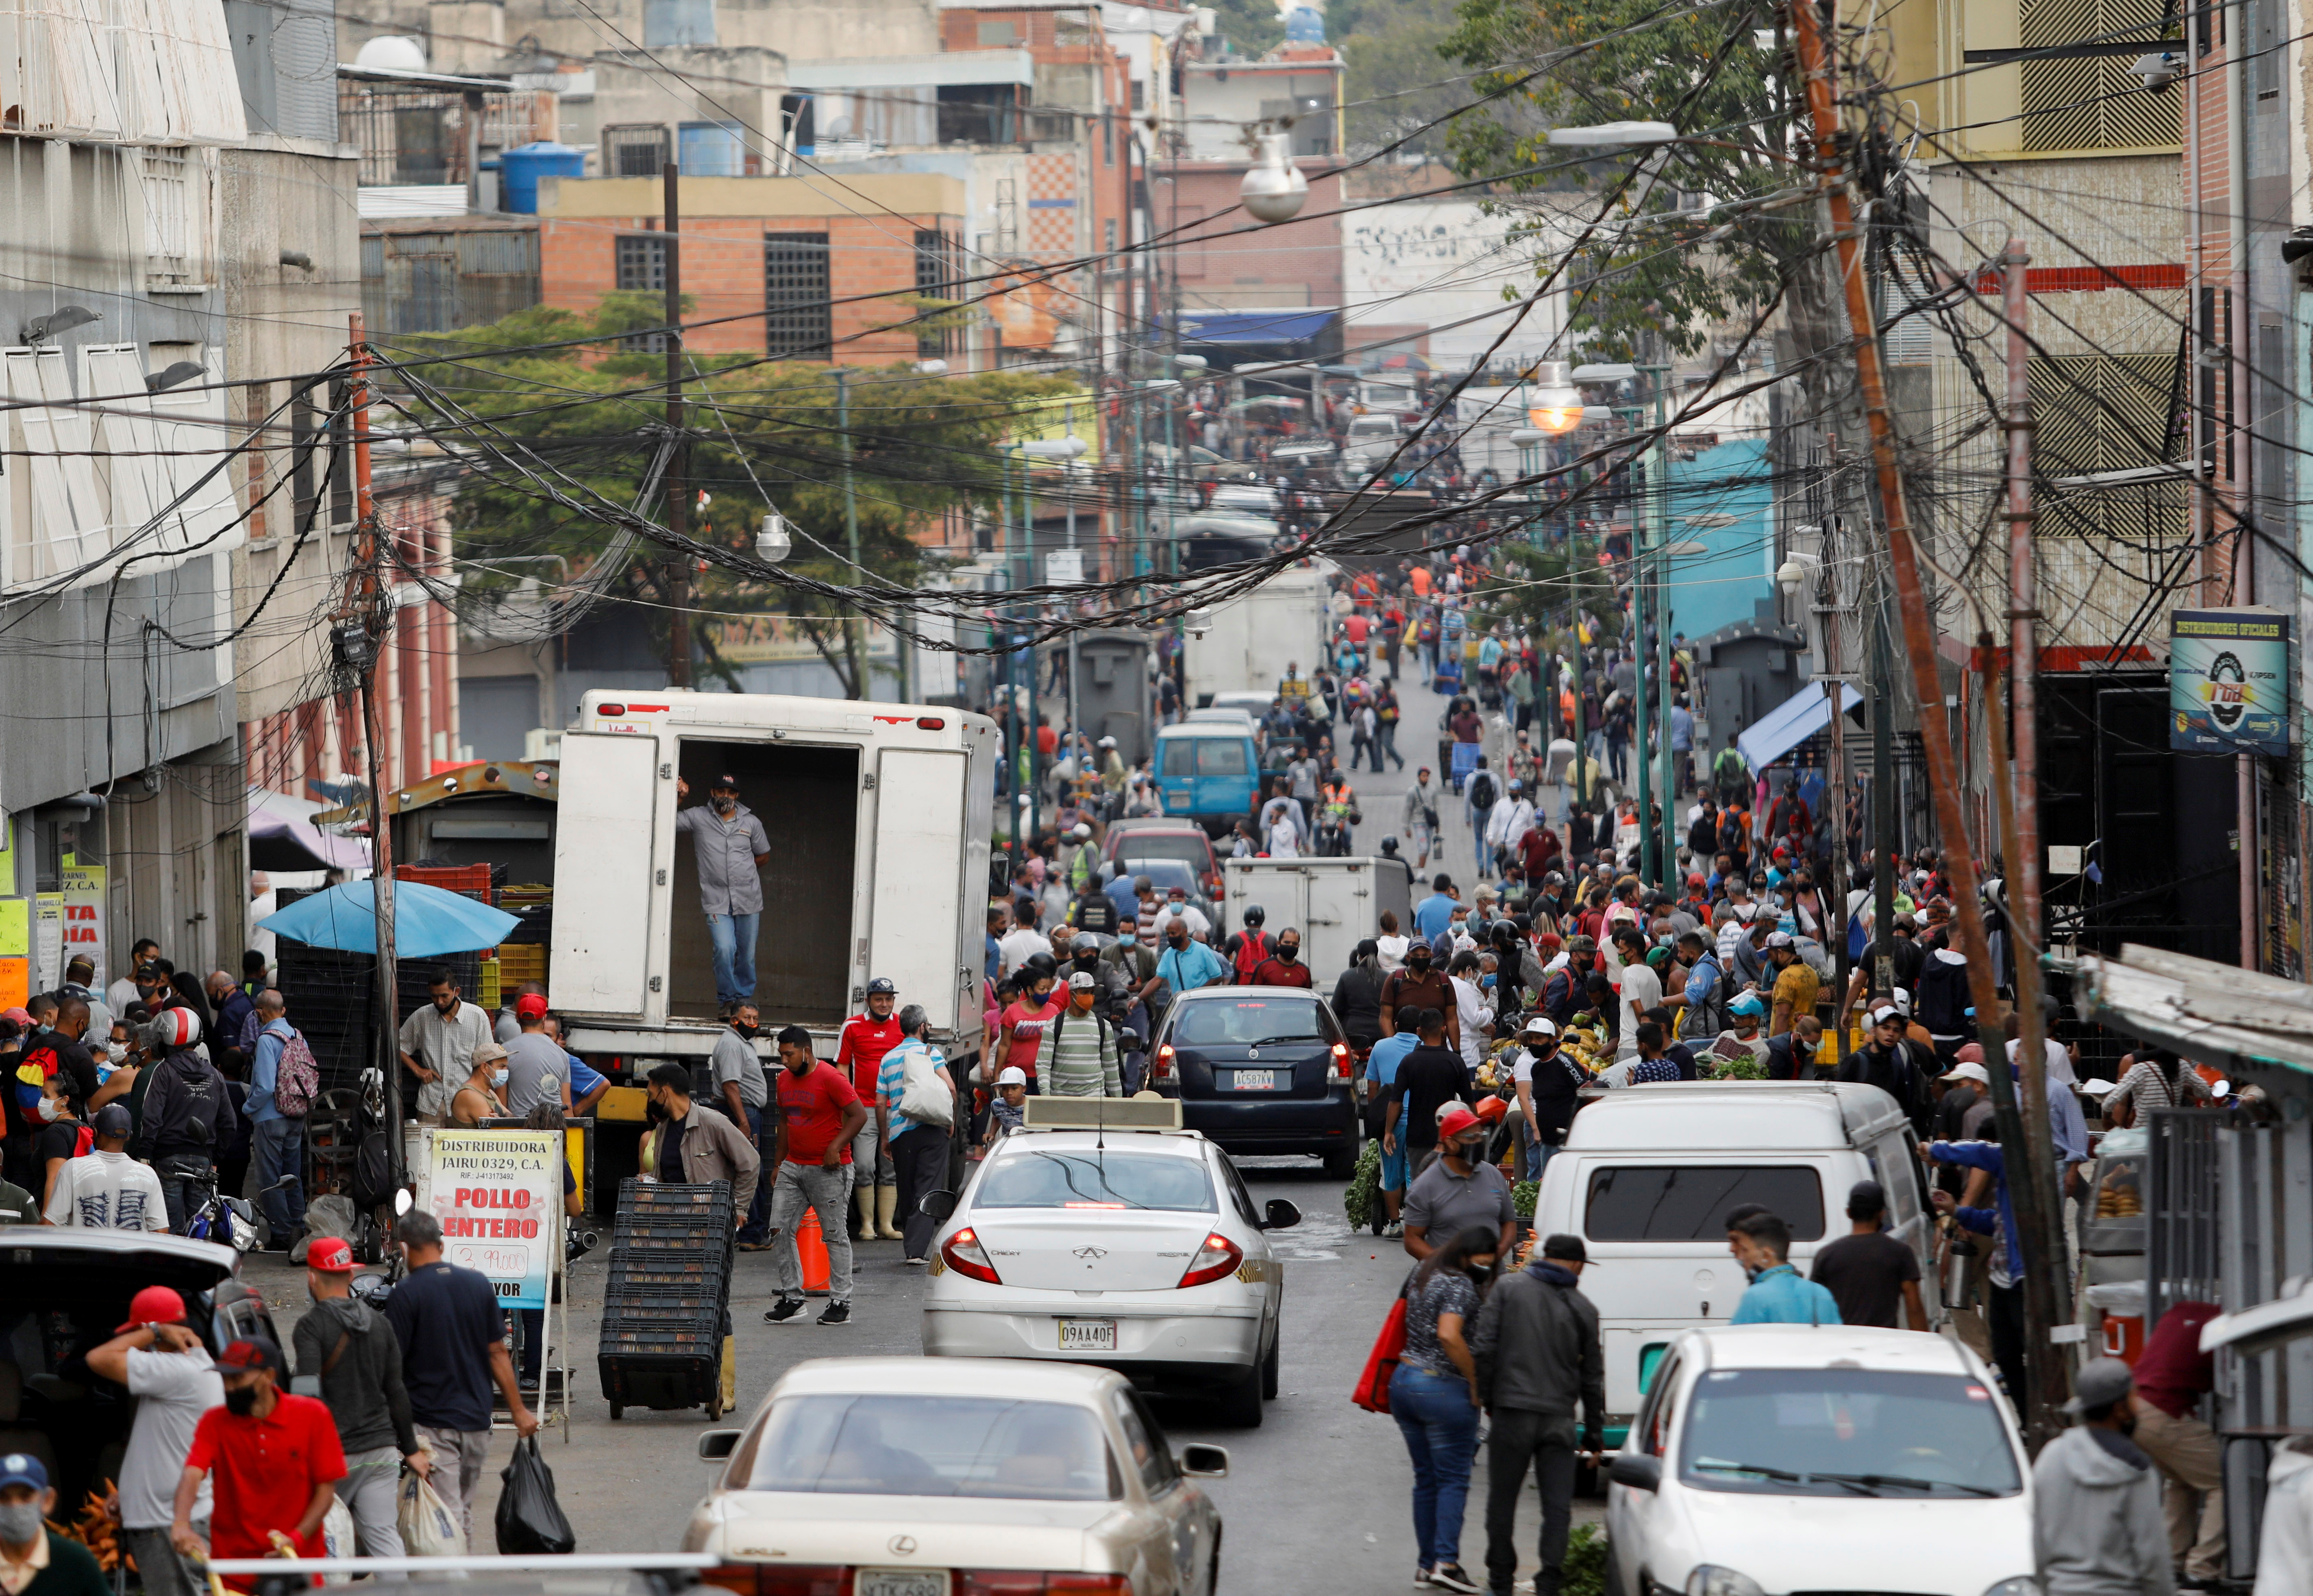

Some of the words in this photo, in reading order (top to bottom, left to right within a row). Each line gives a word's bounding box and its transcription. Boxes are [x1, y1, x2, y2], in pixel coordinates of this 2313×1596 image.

[2240, 624, 2279, 637] OFICIALES
[63, 881, 74, 890] Z,
[78, 881, 98, 890] C.A.
[1236, 1074, 1271, 1085] AC587KV
[441, 1140, 546, 1154] DISTRIBUIDORA
[442, 1157, 478, 1170] JAIRU
[482, 1158, 518, 1171] 0329,
[521, 1159, 544, 1170] C.A.
[455, 1187, 530, 1209] POLLO
[443, 1217, 538, 1239] ENTERO
[492, 1283, 520, 1296] YOR
[1062, 1327, 1114, 1342] 09AA40F
